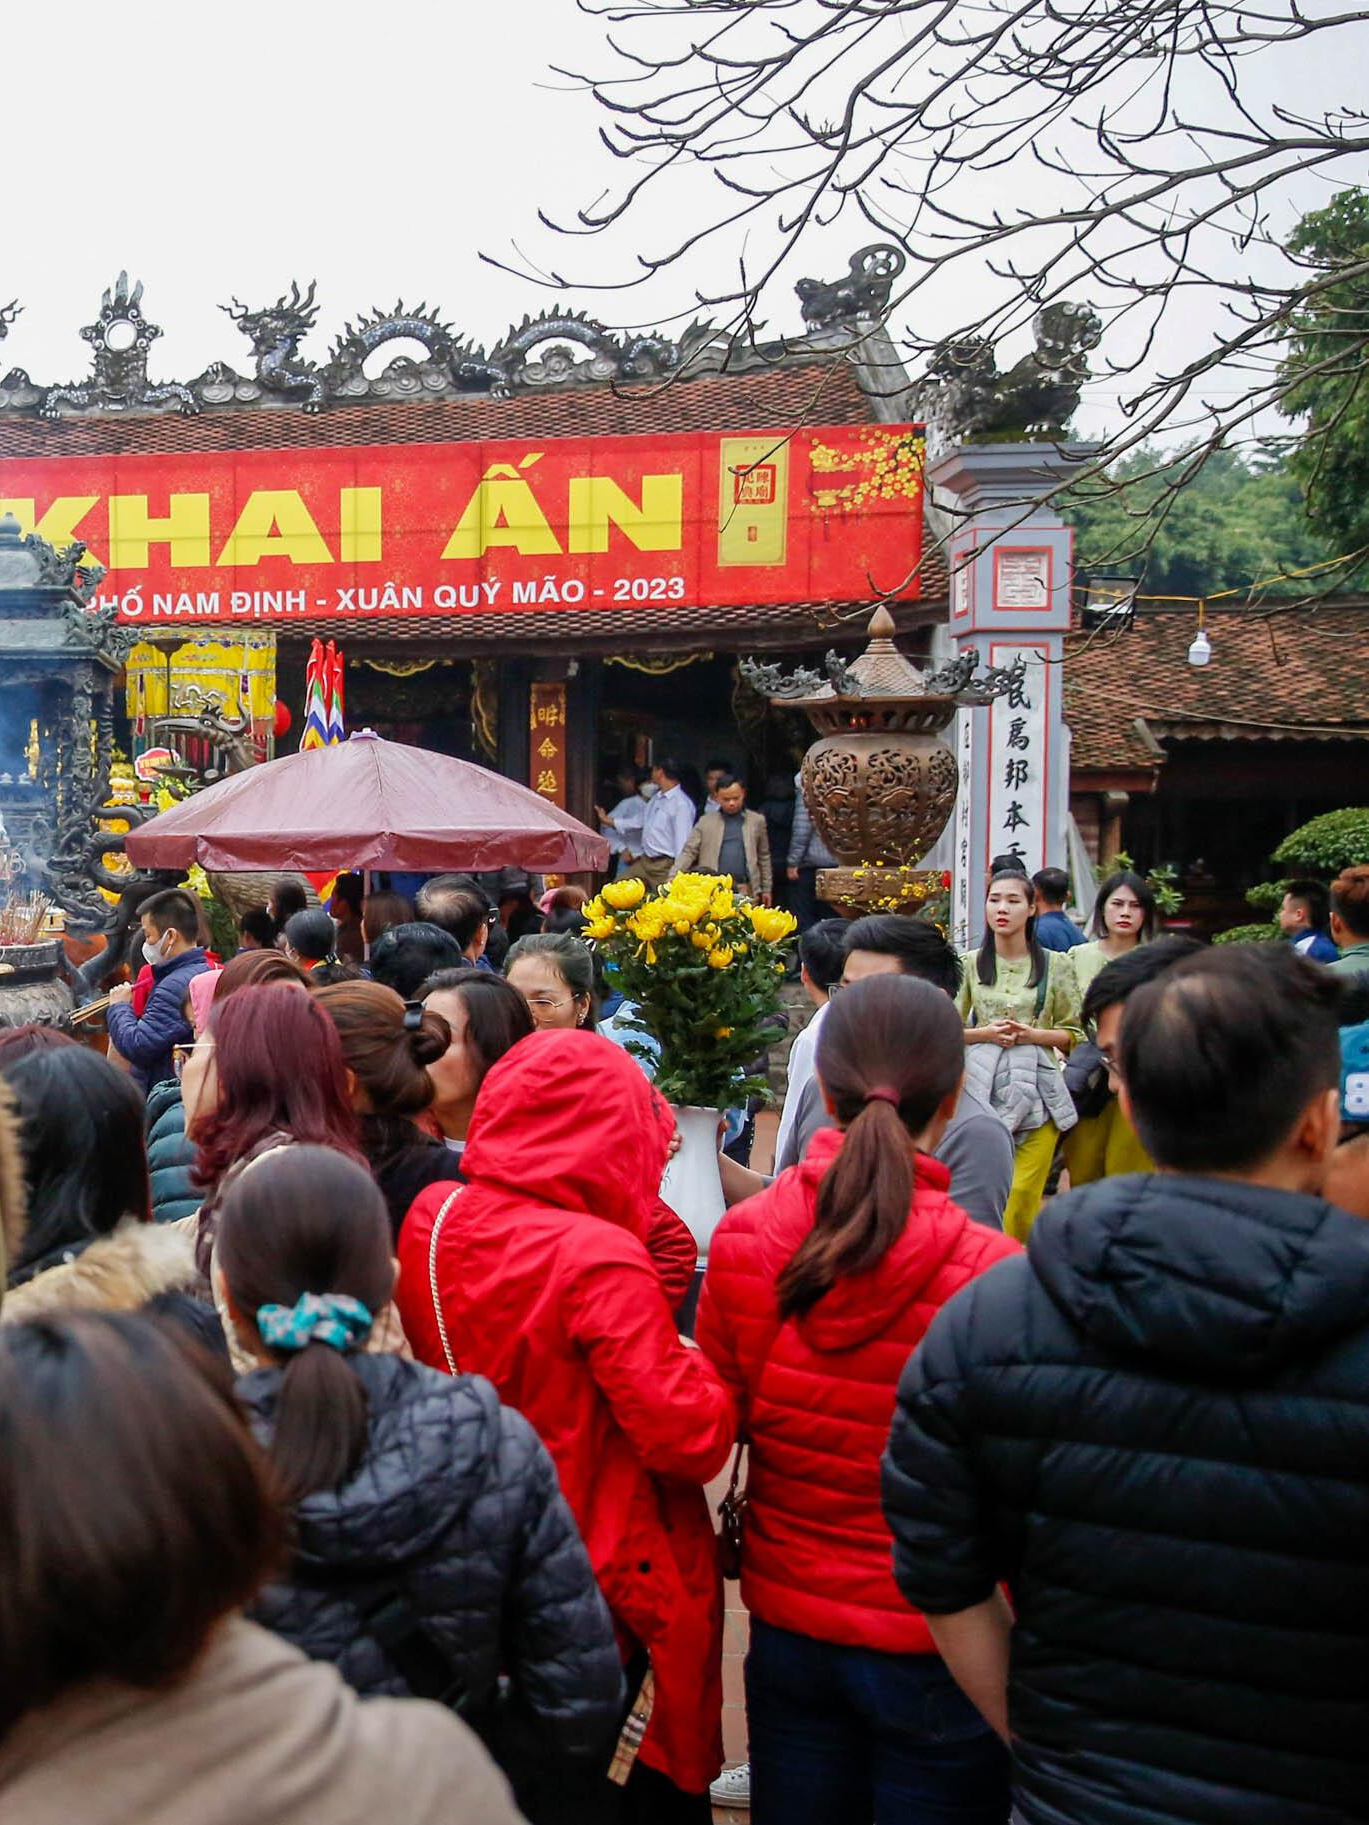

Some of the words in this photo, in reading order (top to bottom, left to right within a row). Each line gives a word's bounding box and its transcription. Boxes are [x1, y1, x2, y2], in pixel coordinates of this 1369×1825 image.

[439, 452, 684, 561] ẤN
[152, 592, 220, 615] NAM
[230, 590, 306, 618] ĐỊNH
[336, 582, 422, 611] XUÂN
[433, 576, 502, 608] QUÝ
[512, 575, 585, 604] MÃO
[613, 577, 686, 601] 2023
